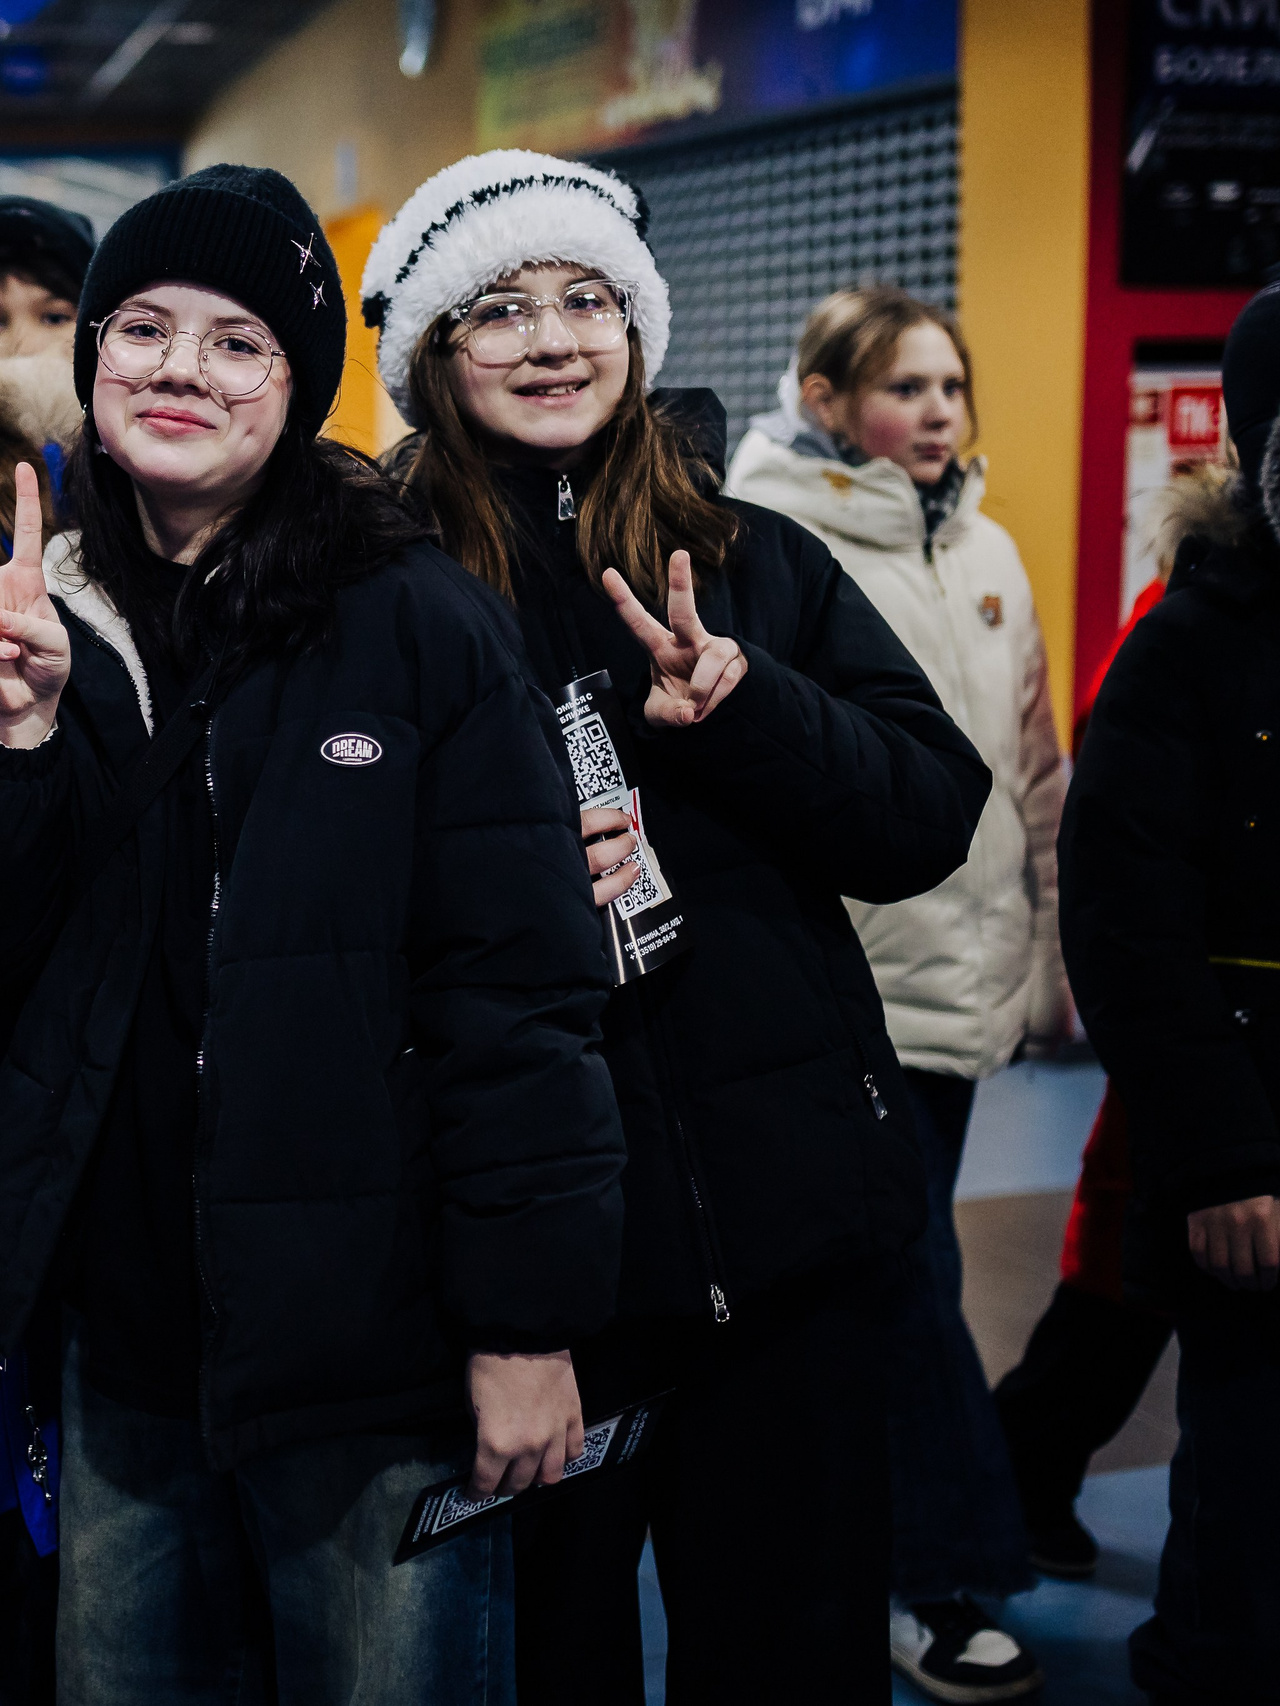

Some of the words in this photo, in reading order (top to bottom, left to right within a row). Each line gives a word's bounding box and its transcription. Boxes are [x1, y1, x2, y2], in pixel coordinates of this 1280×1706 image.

[556, 694, 587, 715] ОМЬСЯ
[559, 704, 591, 724] БЛИЖЕ
[332, 739, 373, 758] DREAM
